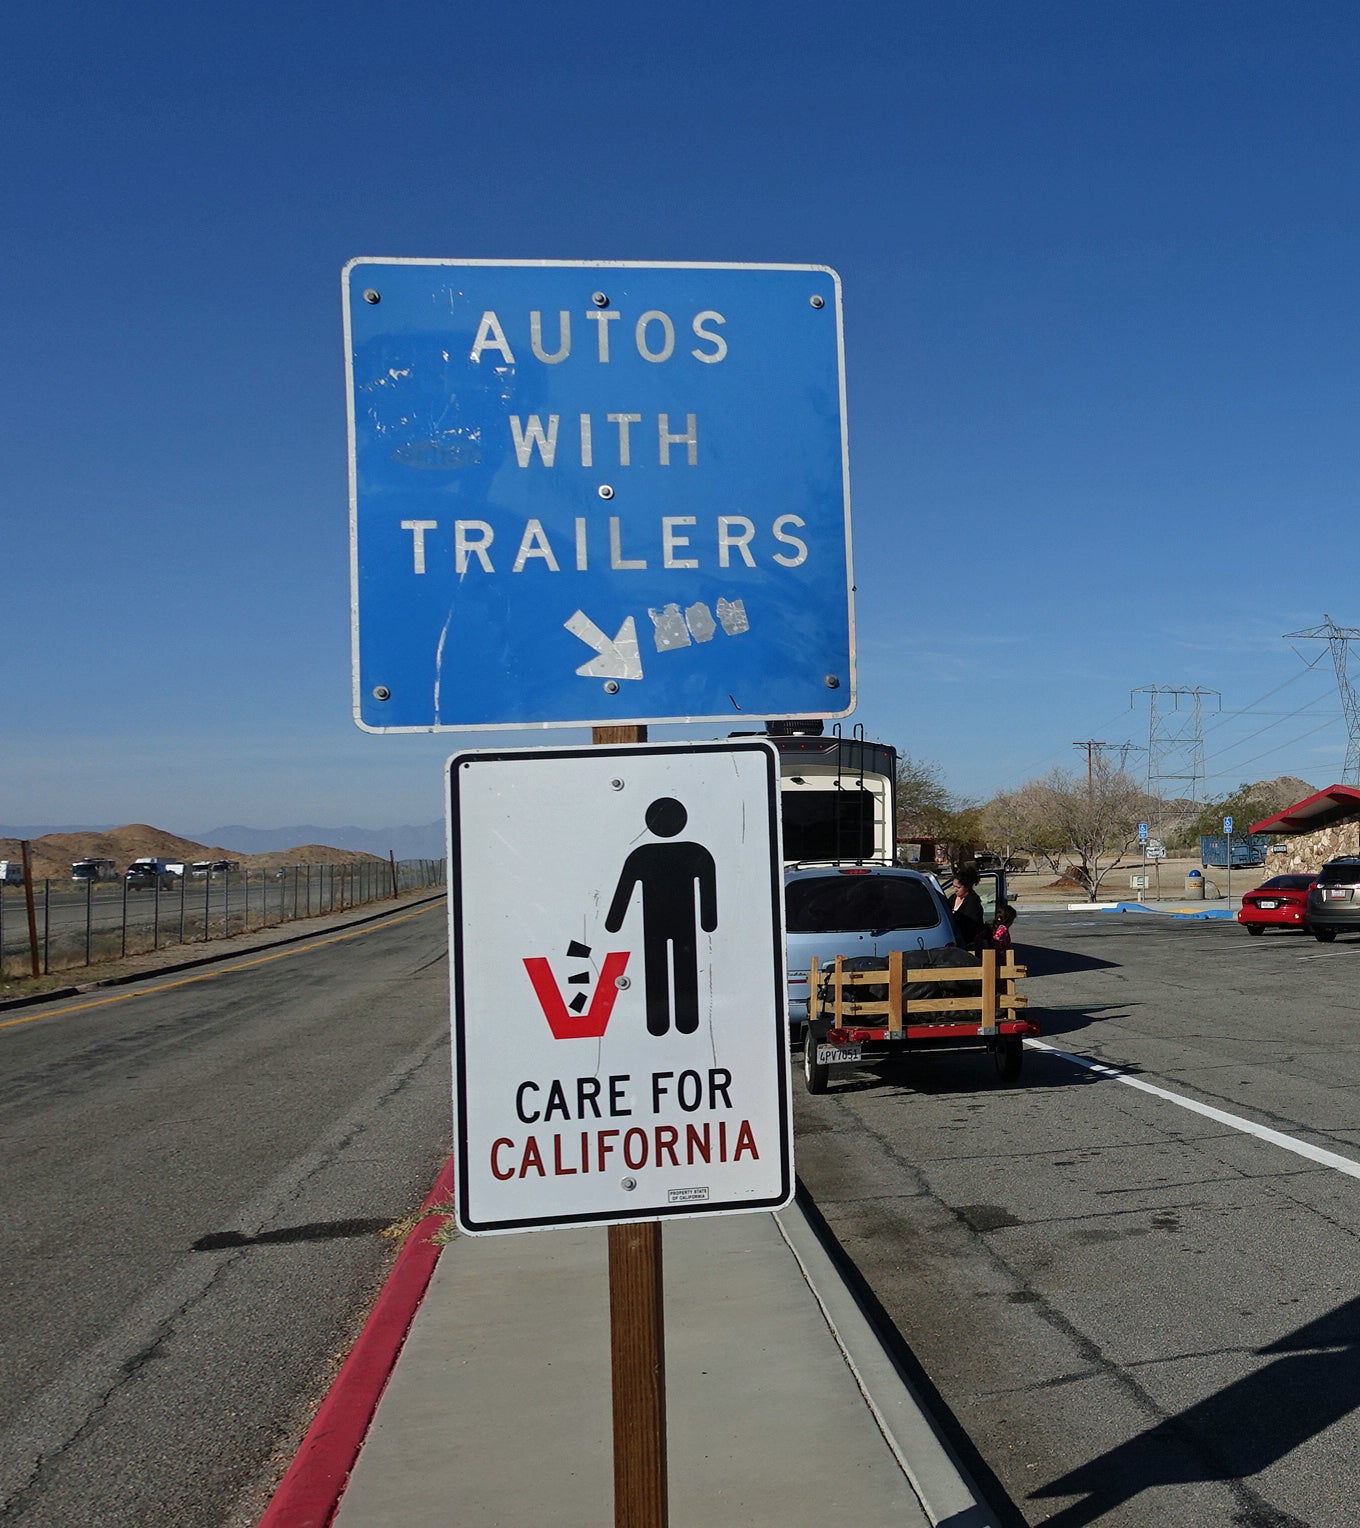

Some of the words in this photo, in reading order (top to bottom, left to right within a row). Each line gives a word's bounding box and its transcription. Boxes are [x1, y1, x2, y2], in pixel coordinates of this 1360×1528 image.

[470, 309, 728, 364] AUTOS
[508, 413, 698, 468] WITH
[401, 513, 809, 574] TRAILERS
[820, 1048, 859, 1064] 4PV7051
[516, 1074, 632, 1124] CARE
[652, 1067, 733, 1114] FOR
[490, 1120, 759, 1181] CALIFORNIA
